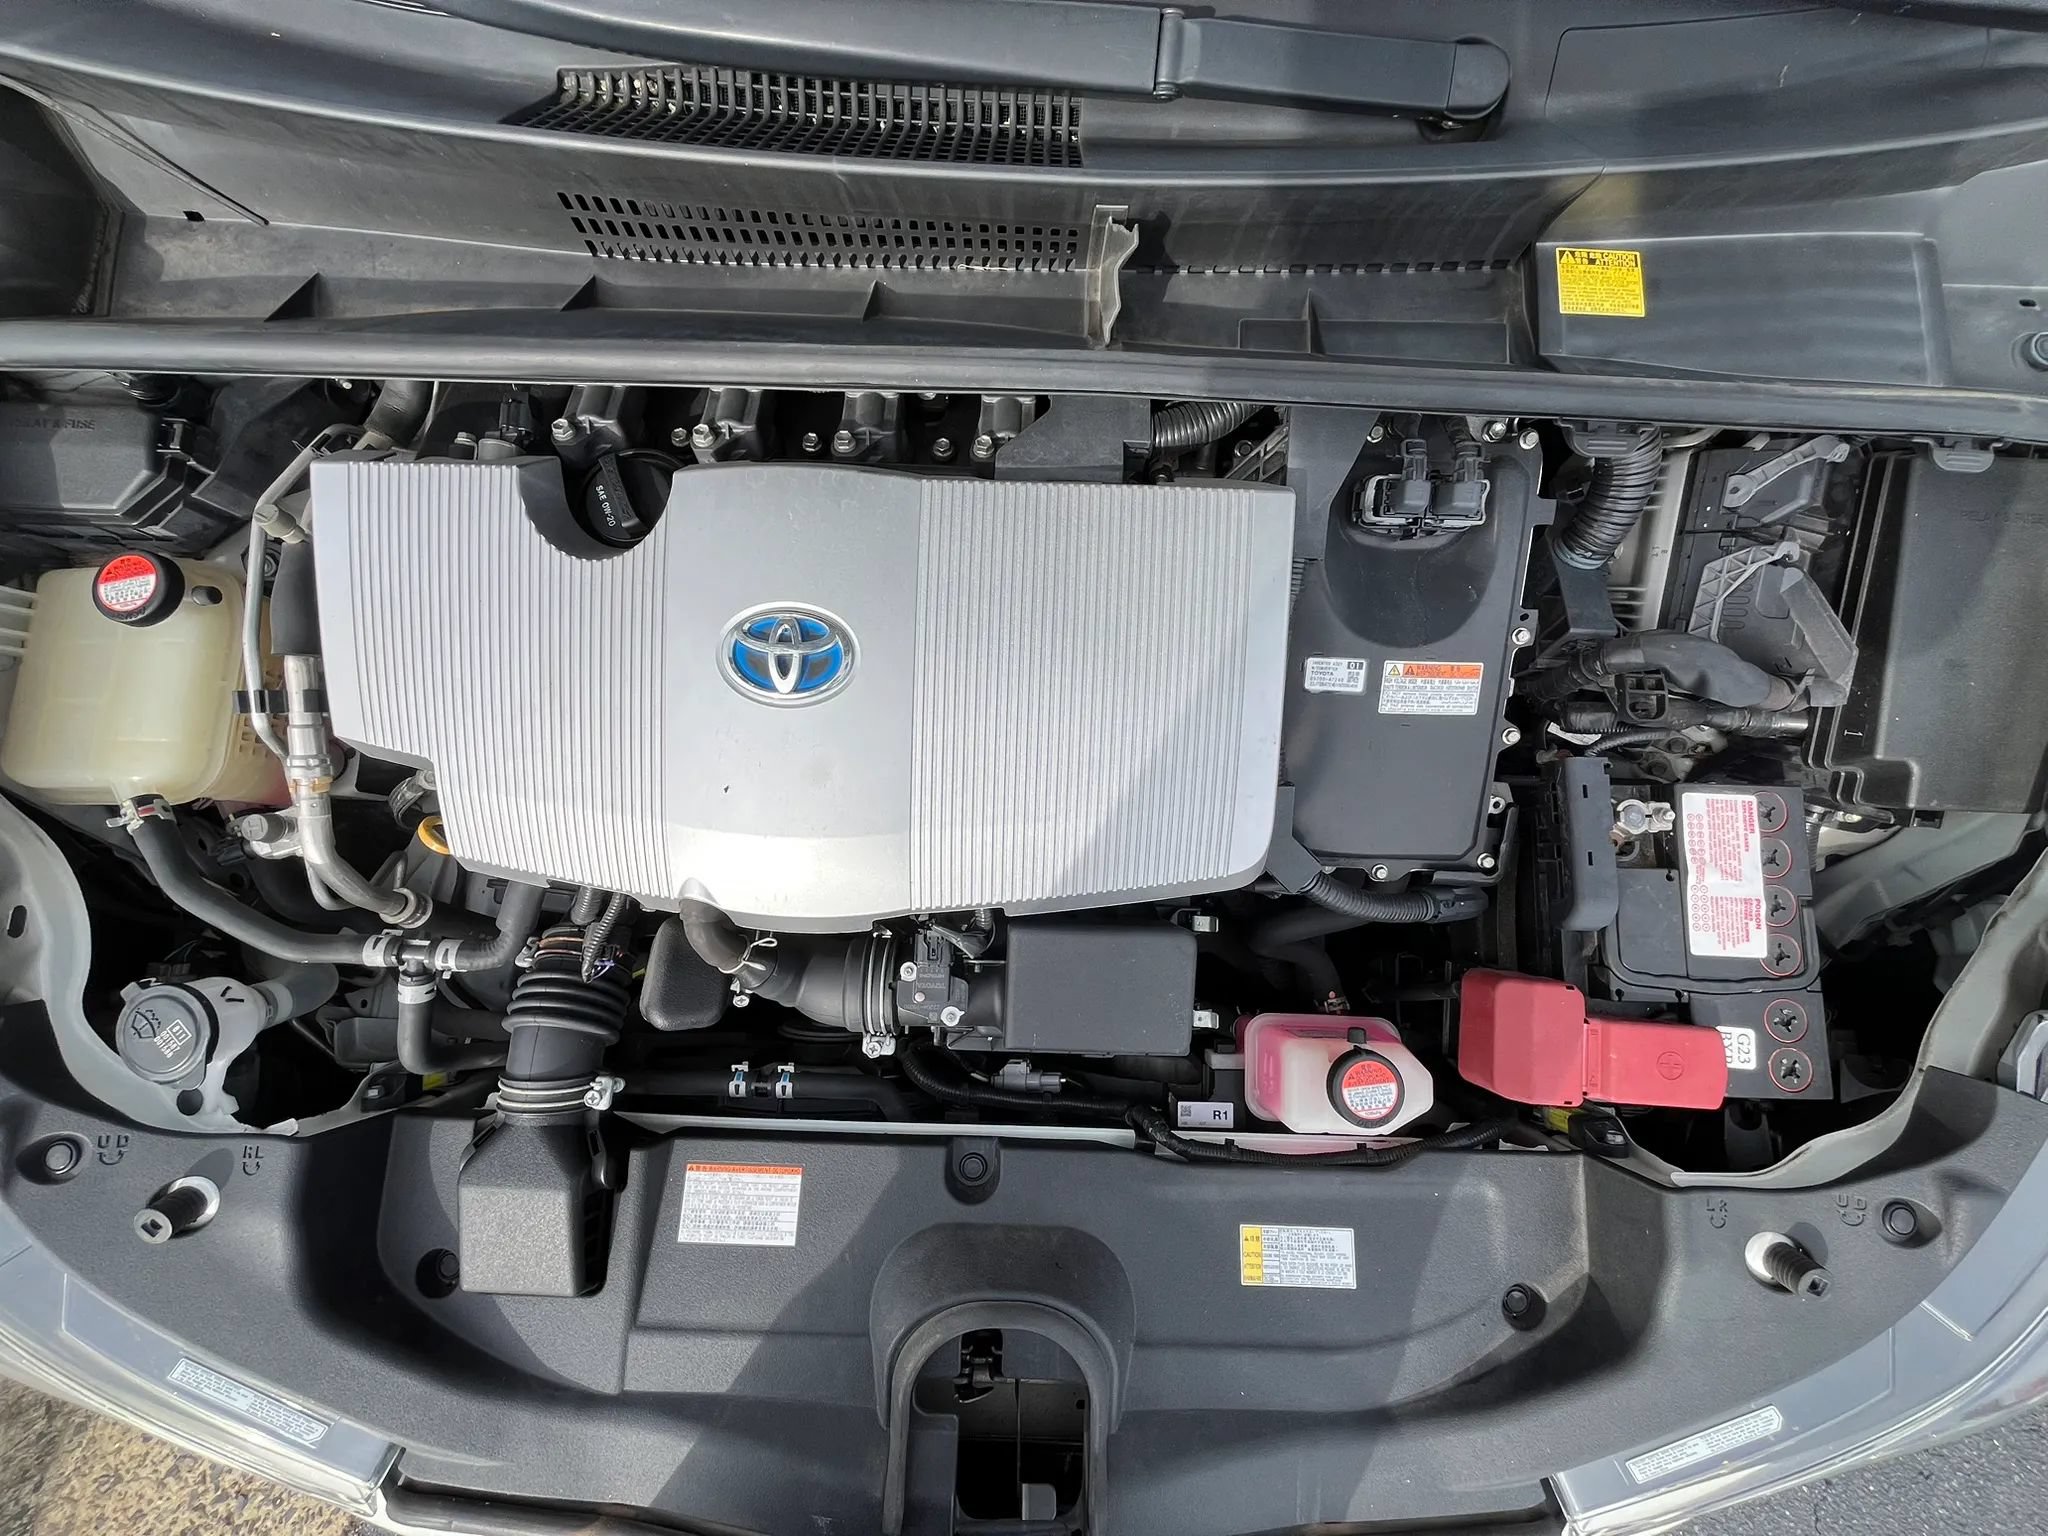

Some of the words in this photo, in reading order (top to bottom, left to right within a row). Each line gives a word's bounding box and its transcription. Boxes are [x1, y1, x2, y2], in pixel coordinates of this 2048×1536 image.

[595, 485, 607, 501] SAE
[601, 502, 616, 527] 0W-20
[1747, 800, 1756, 834] DANGER
[1754, 898, 1762, 930] POISON
[1737, 1033, 1751, 1064] G23
[1213, 1110, 1228, 1121] R1
